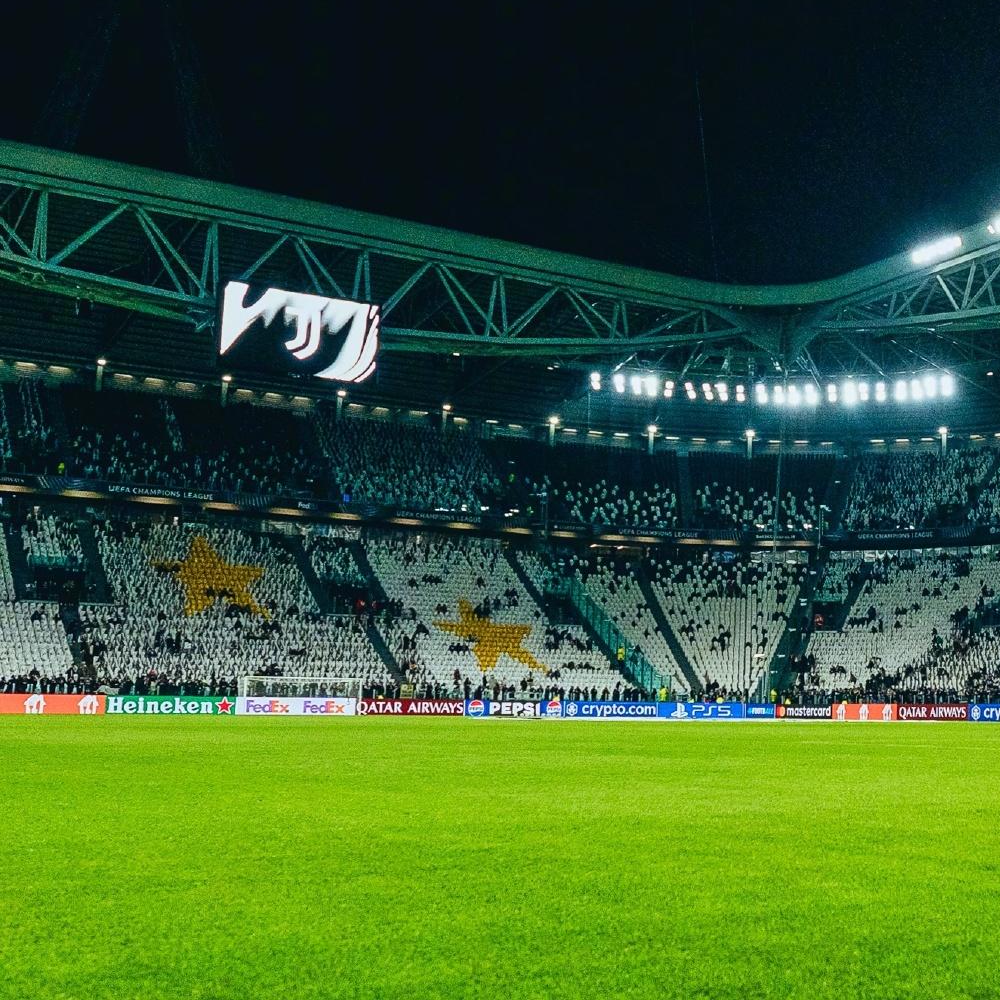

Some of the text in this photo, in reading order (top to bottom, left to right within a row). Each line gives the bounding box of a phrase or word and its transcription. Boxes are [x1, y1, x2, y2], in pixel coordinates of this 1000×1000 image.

[108, 485, 214, 500] UEFA CHAMPIONS LEAGUE
[107, 697, 213, 714] Heineken
[246, 700, 289, 714] FedEx
[303, 701, 345, 714] FedEx
[356, 701, 464, 715] QATAR AIRWAYS
[489, 702, 541, 716] PEPSI
[582, 703, 657, 717] crypto.com
[692, 705, 731, 717] PS5
[786, 705, 832, 717] mastercard
[899, 706, 967, 718] QATAR AIRWAYS
